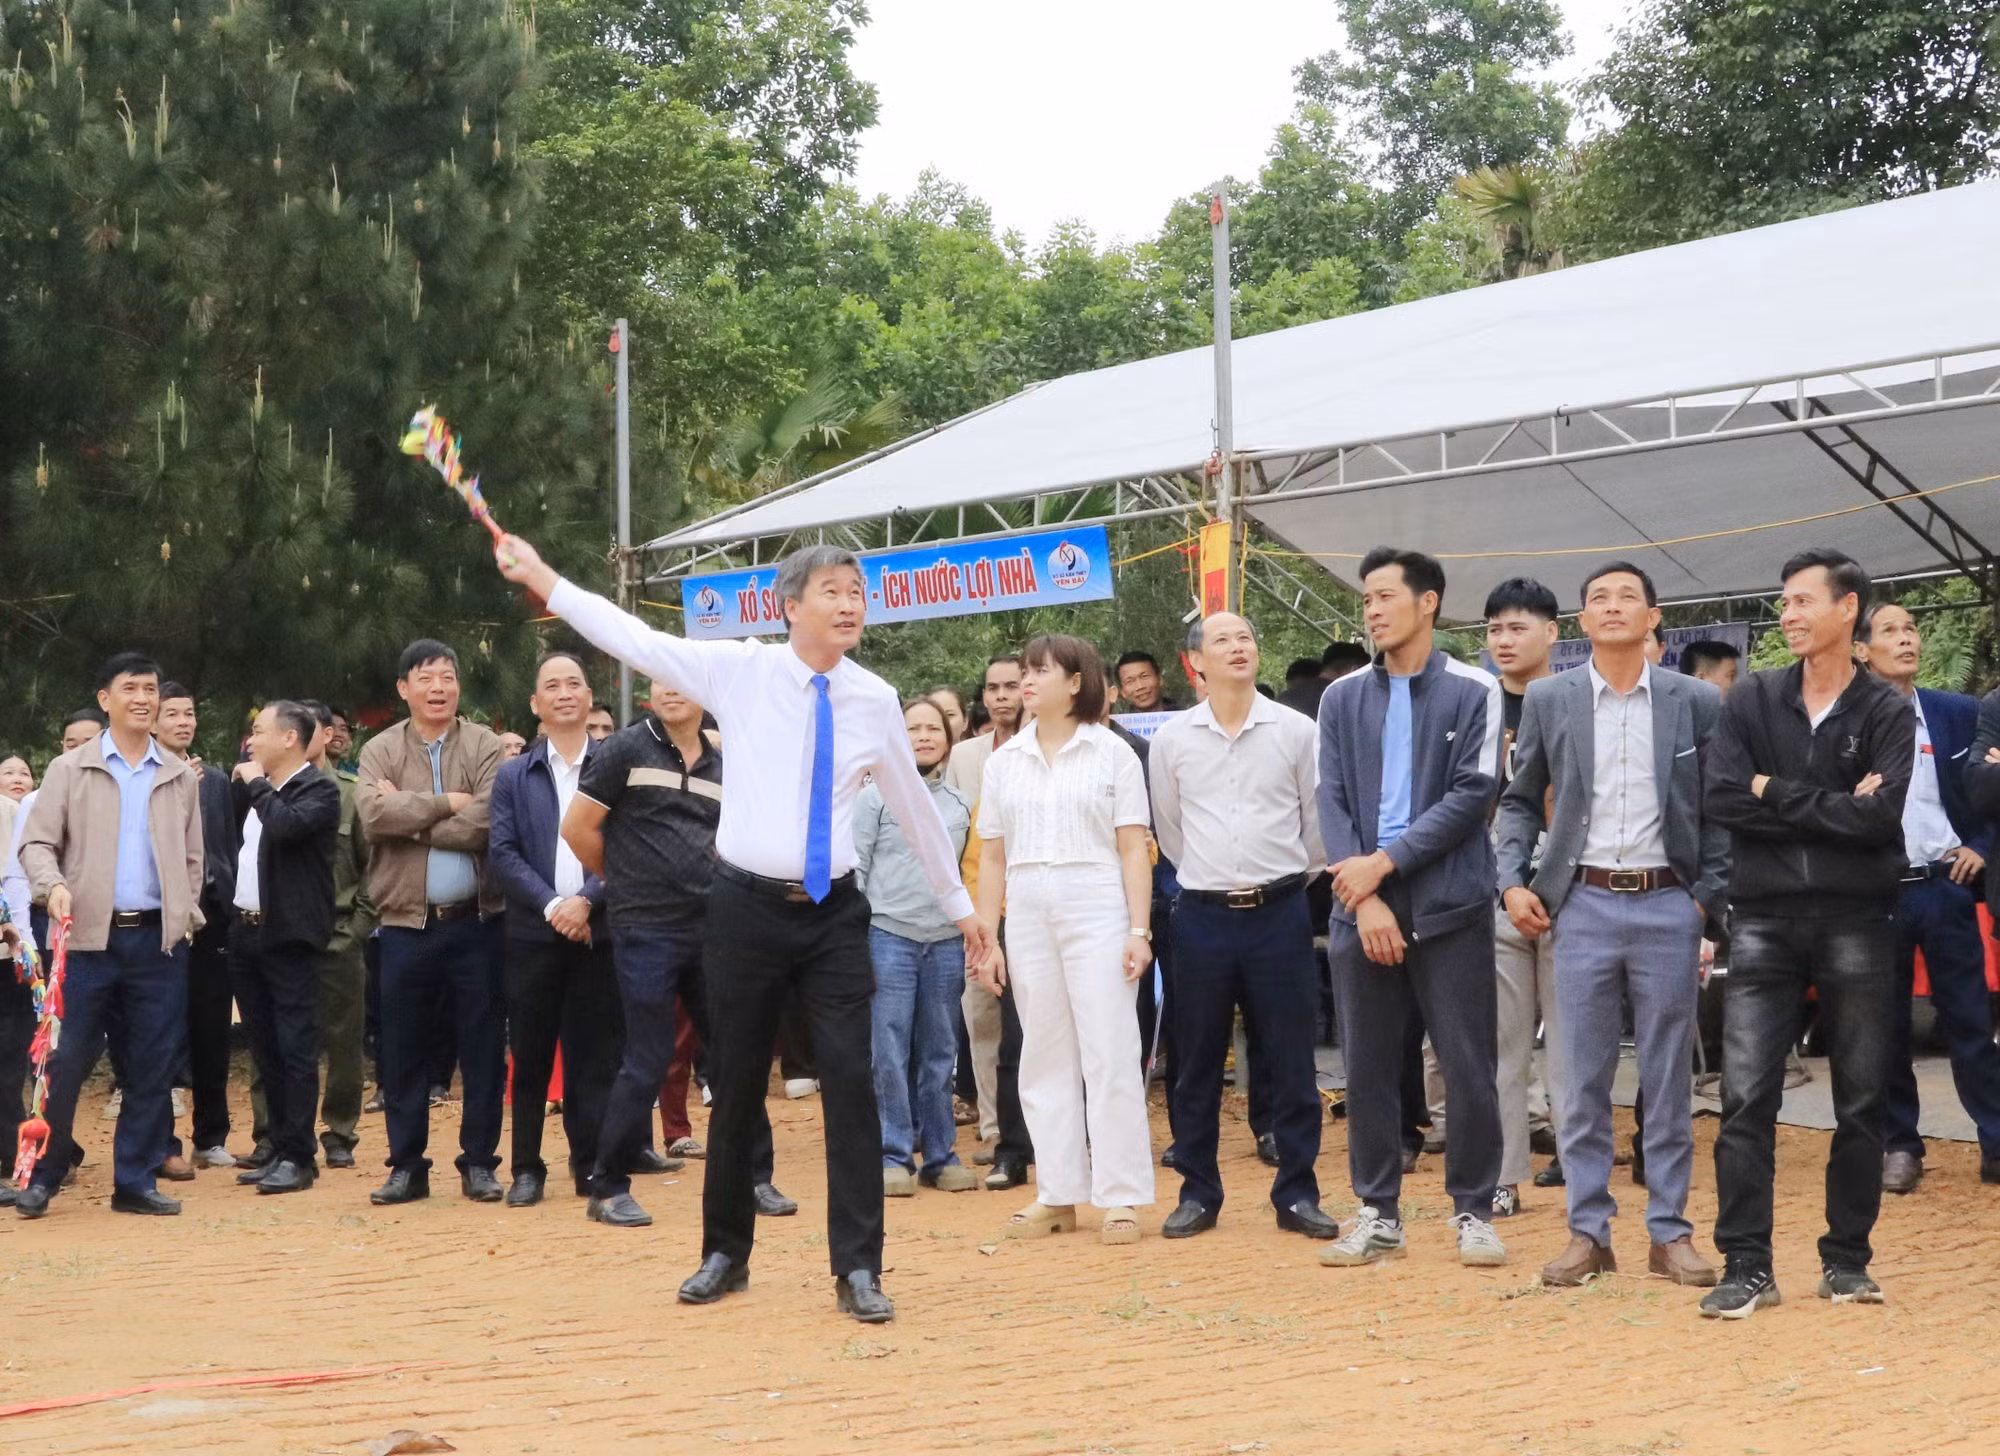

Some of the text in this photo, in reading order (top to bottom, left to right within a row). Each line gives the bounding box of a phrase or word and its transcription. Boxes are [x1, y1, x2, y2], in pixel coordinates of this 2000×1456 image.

[737, 576, 759, 624] XỔ
[882, 567, 912, 609] ÍCH
[914, 560, 961, 605] NƯỚC
[964, 558, 995, 606] LỢI
[997, 549, 1038, 596] NHÀ
